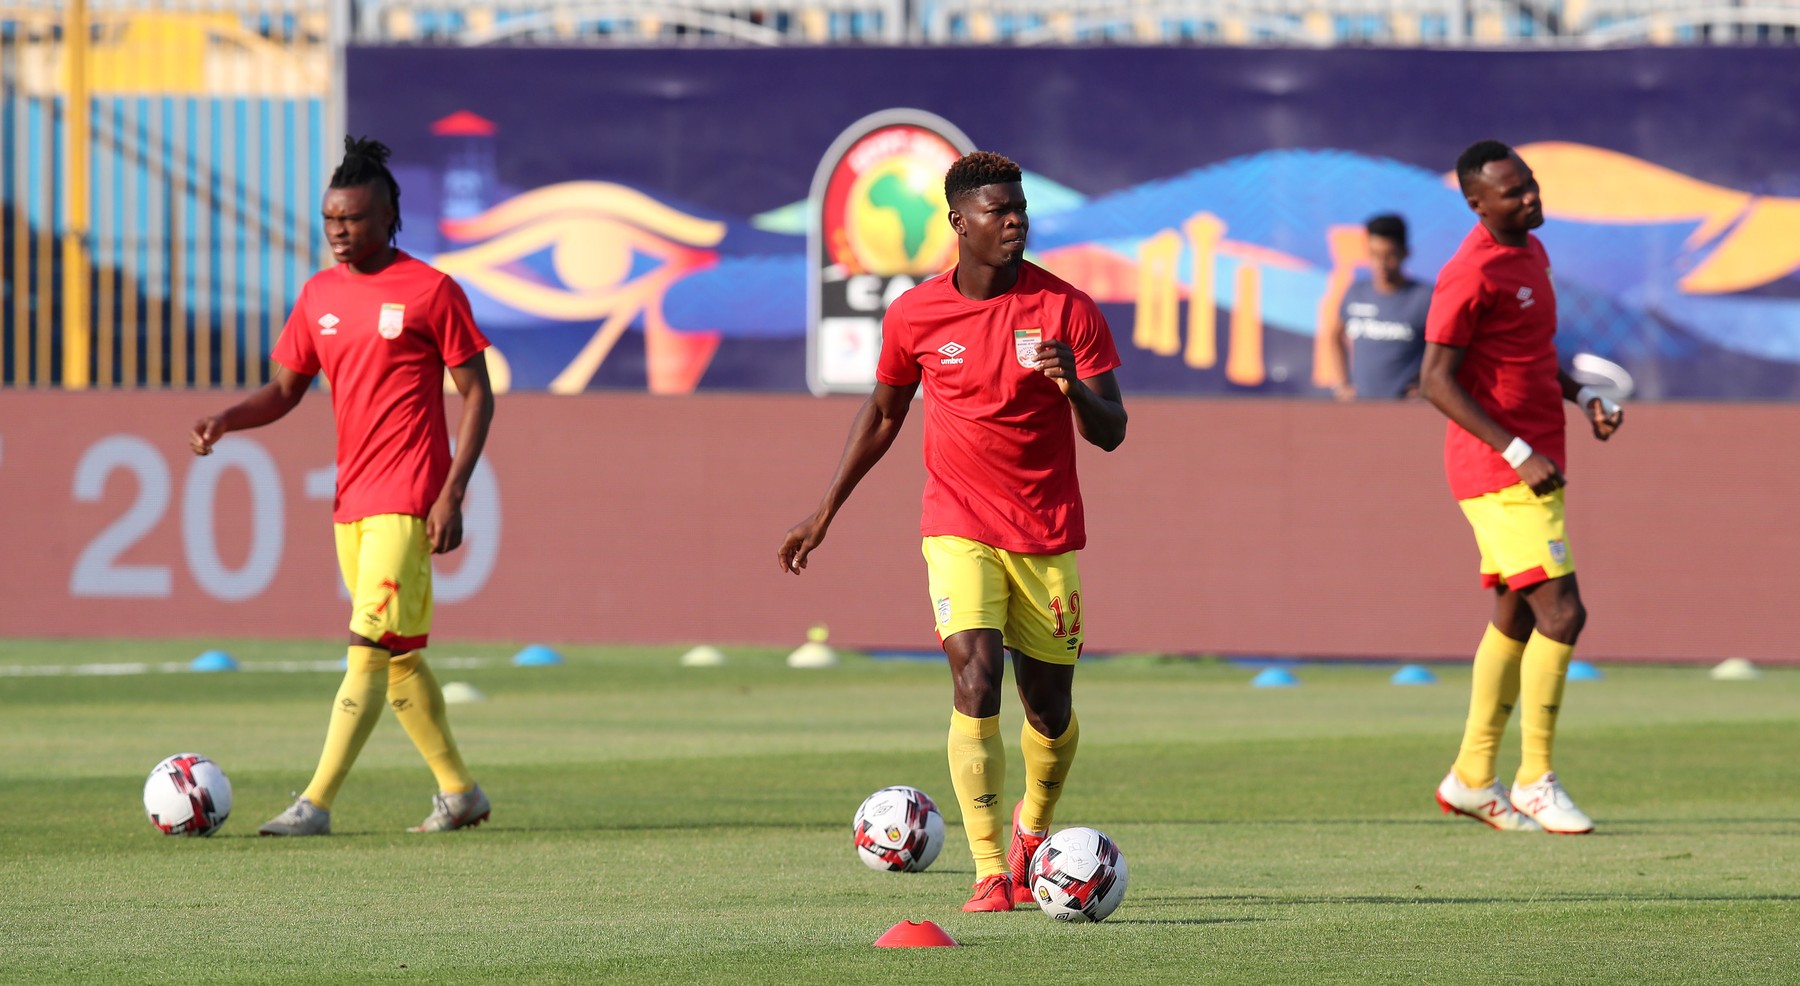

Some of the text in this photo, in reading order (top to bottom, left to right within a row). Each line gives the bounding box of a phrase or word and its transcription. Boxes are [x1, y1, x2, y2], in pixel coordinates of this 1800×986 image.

[69, 434, 501, 601] 209
[377, 579, 400, 613] 7
[1048, 590, 1081, 638] 12
